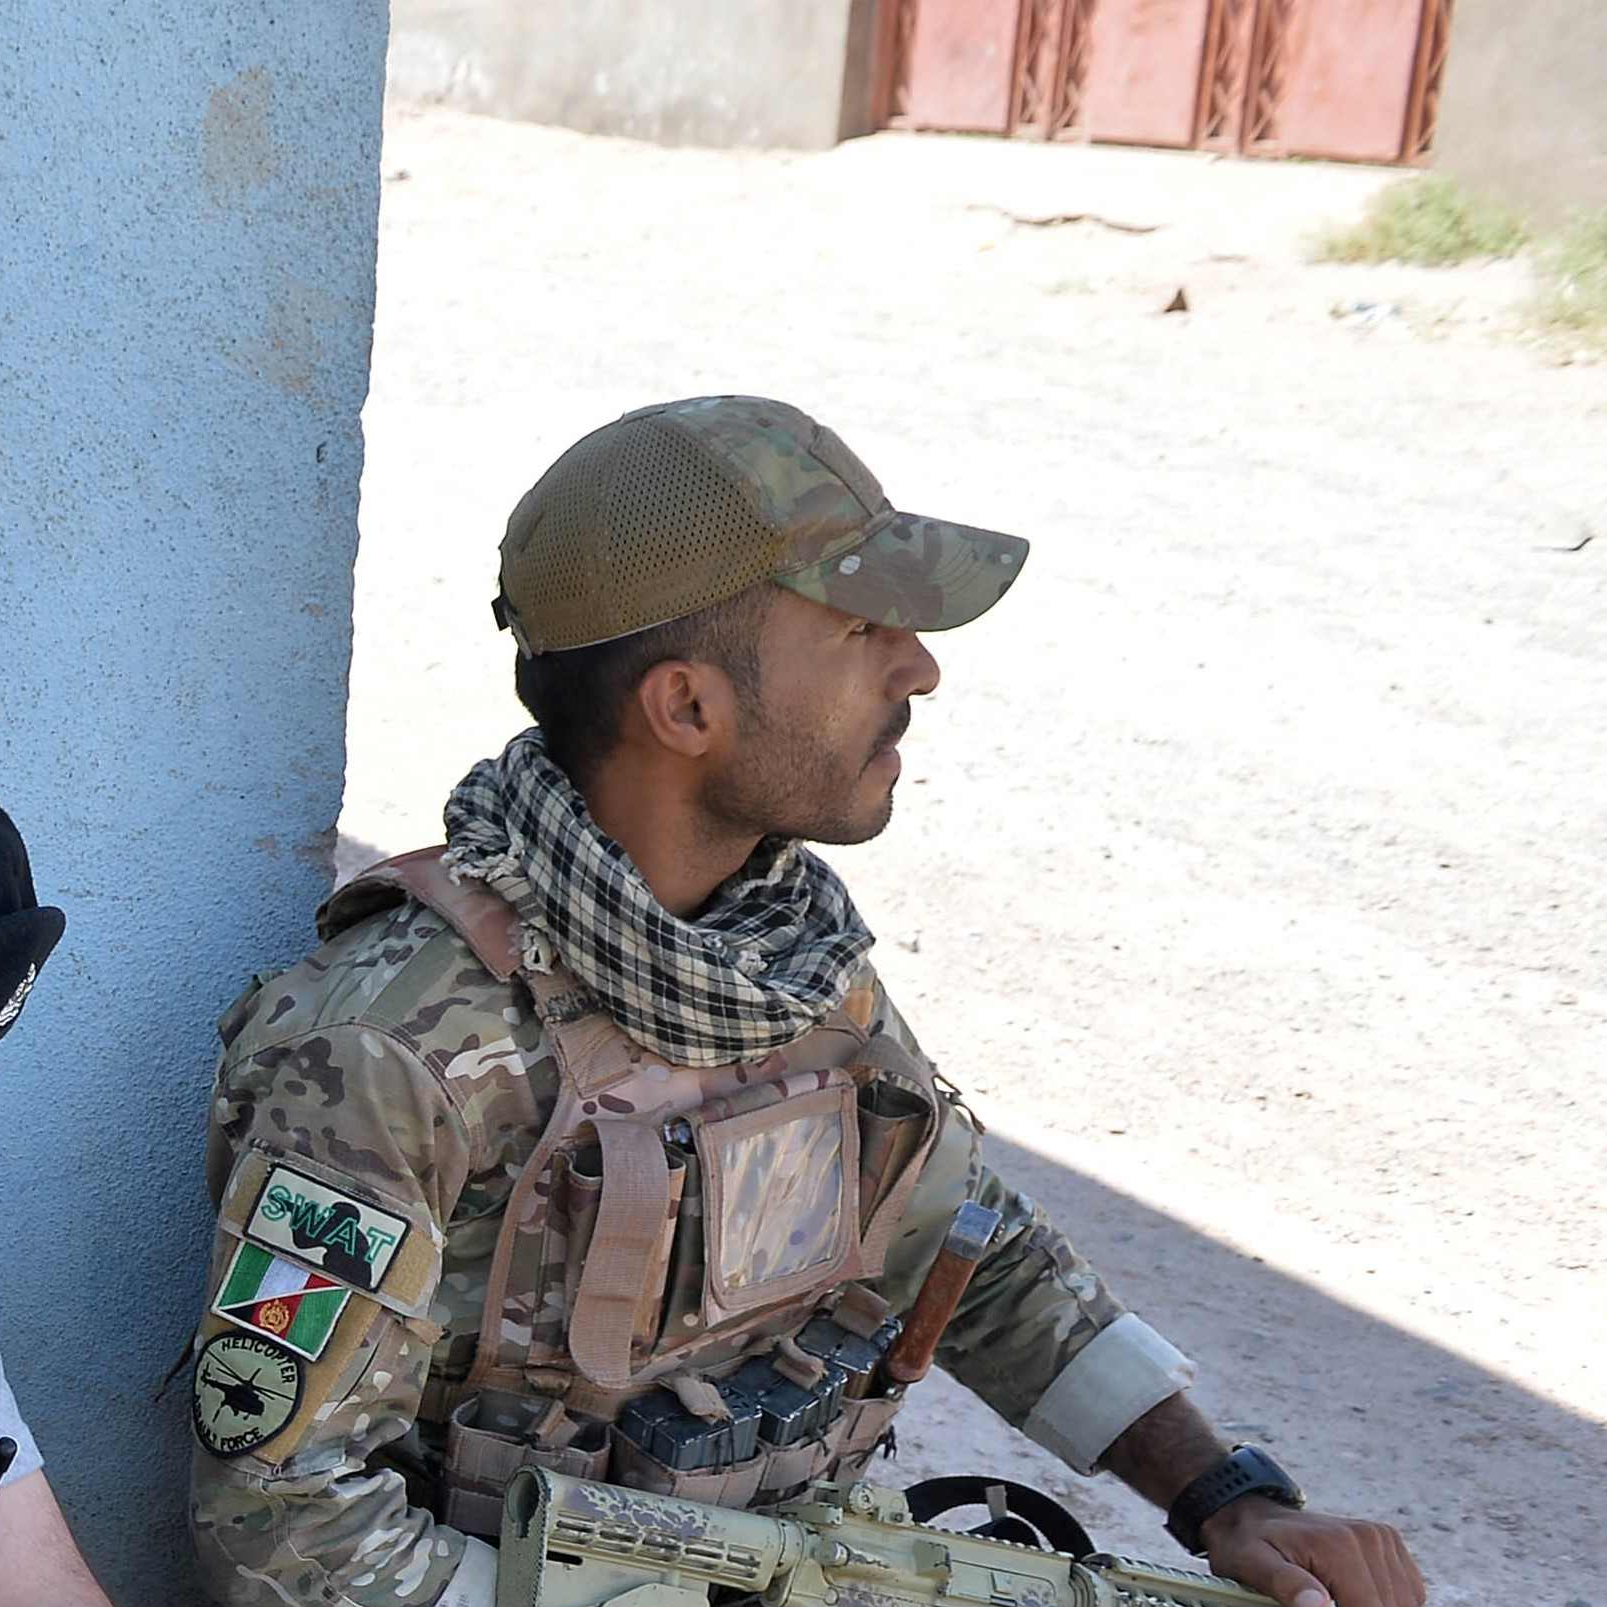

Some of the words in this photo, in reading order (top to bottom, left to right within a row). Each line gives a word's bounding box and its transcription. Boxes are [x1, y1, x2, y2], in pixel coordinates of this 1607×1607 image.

[261, 1185, 396, 1264] SWAT
[221, 1337, 296, 1383] HELICOPTER
[220, 1426, 264, 1450] FORCE
